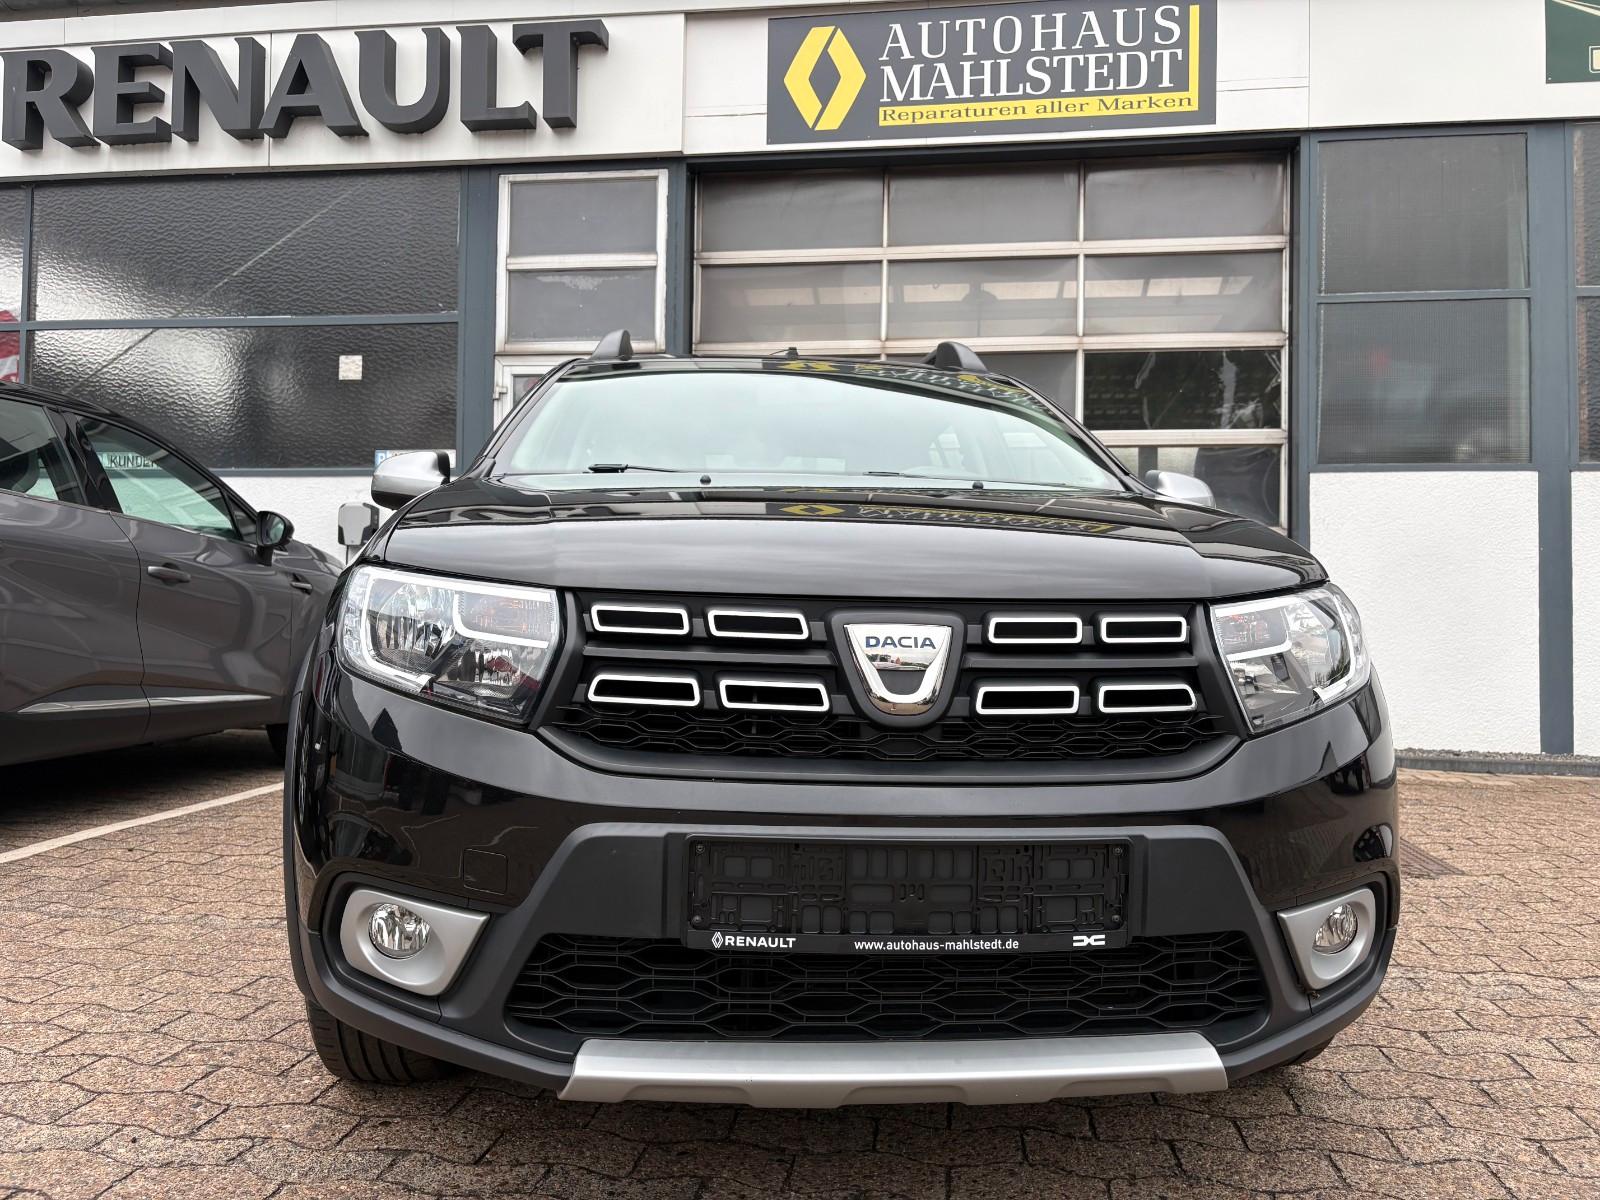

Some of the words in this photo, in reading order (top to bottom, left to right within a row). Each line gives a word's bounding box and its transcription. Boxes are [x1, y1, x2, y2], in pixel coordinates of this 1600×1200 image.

[878, 5, 1181, 61] AUTOHAUS
[1, 20, 609, 150] RENAULT
[879, 49, 1183, 103] MAHLSTEDT
[881, 103, 1026, 123] Reparaturen
[1034, 101, 1089, 114] aller
[1097, 95, 1193, 111] Marken
[865, 636, 936, 649] DACIA
[725, 935, 796, 949] RENAULT
[854, 939, 1019, 951] www.autohaus-mahlstedt.de
